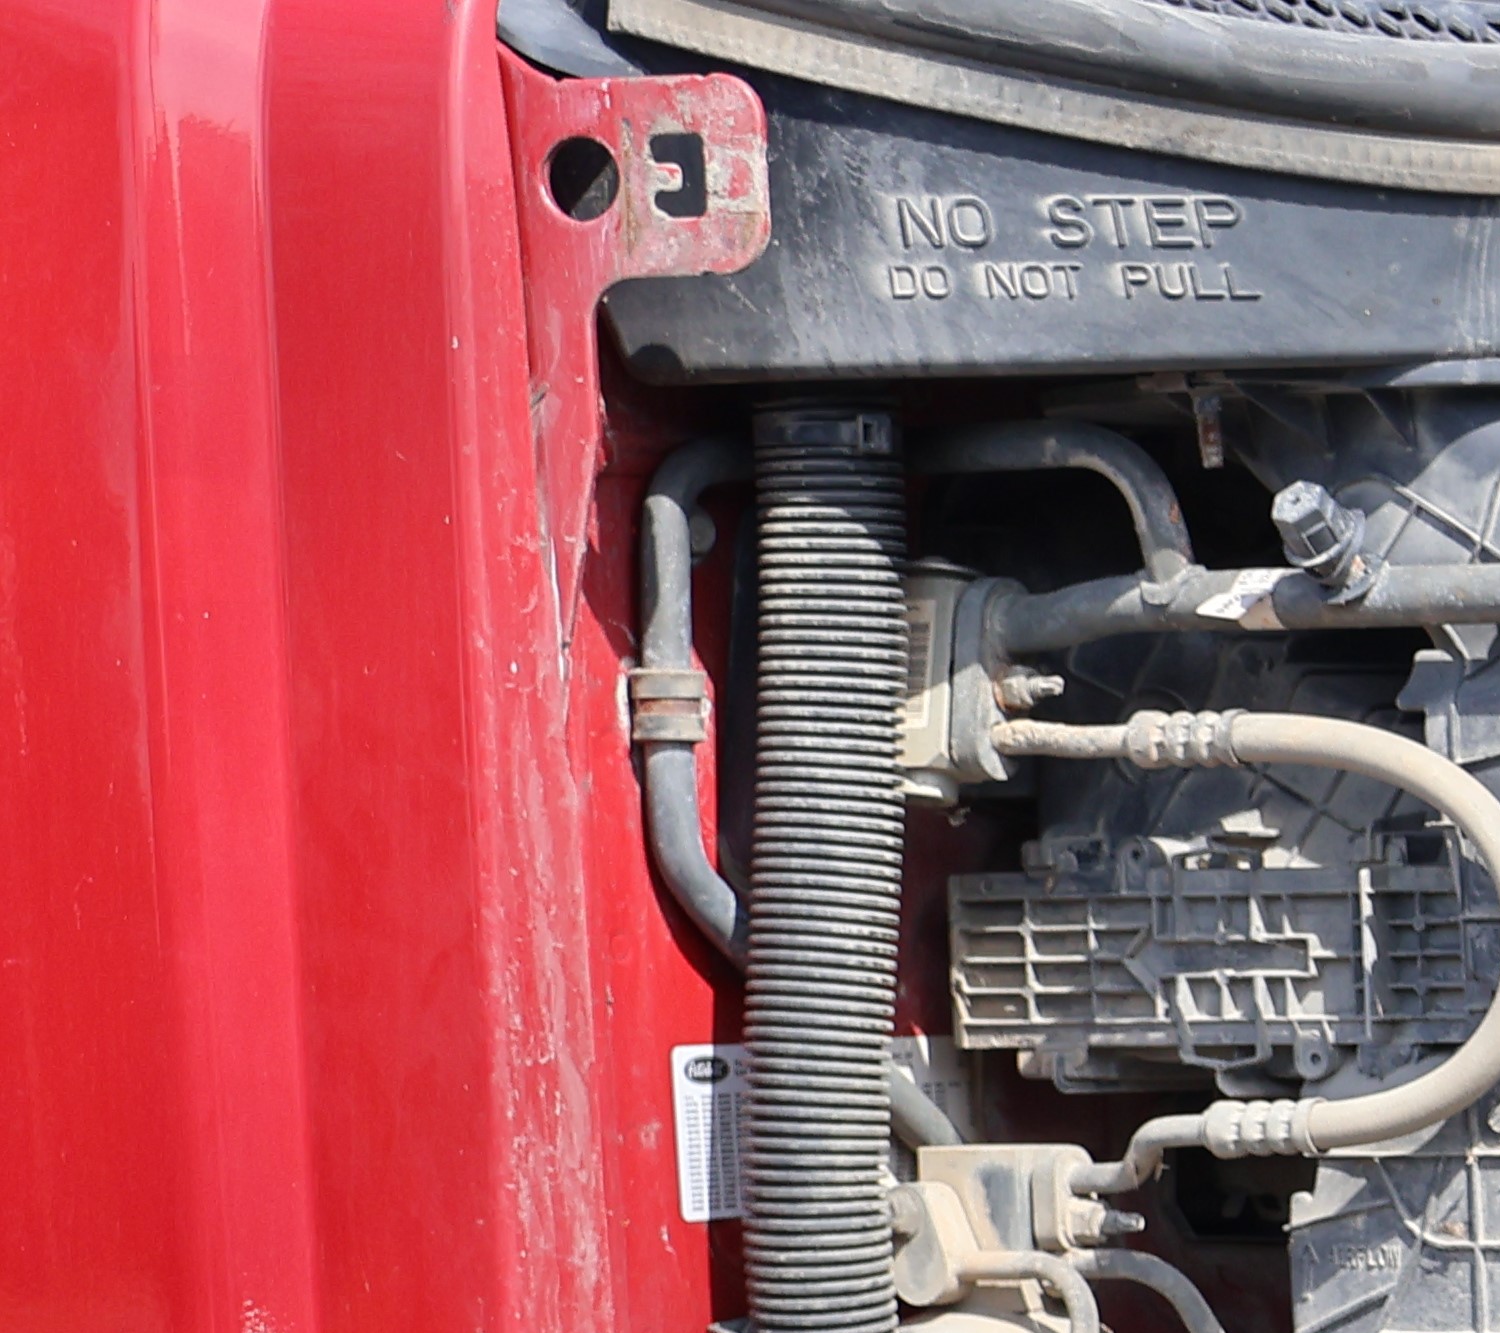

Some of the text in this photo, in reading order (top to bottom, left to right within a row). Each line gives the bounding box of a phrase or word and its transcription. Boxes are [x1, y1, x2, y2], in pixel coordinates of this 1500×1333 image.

[896, 195, 1244, 252] NO STEP
[889, 263, 1262, 300] DO NOT PULL
